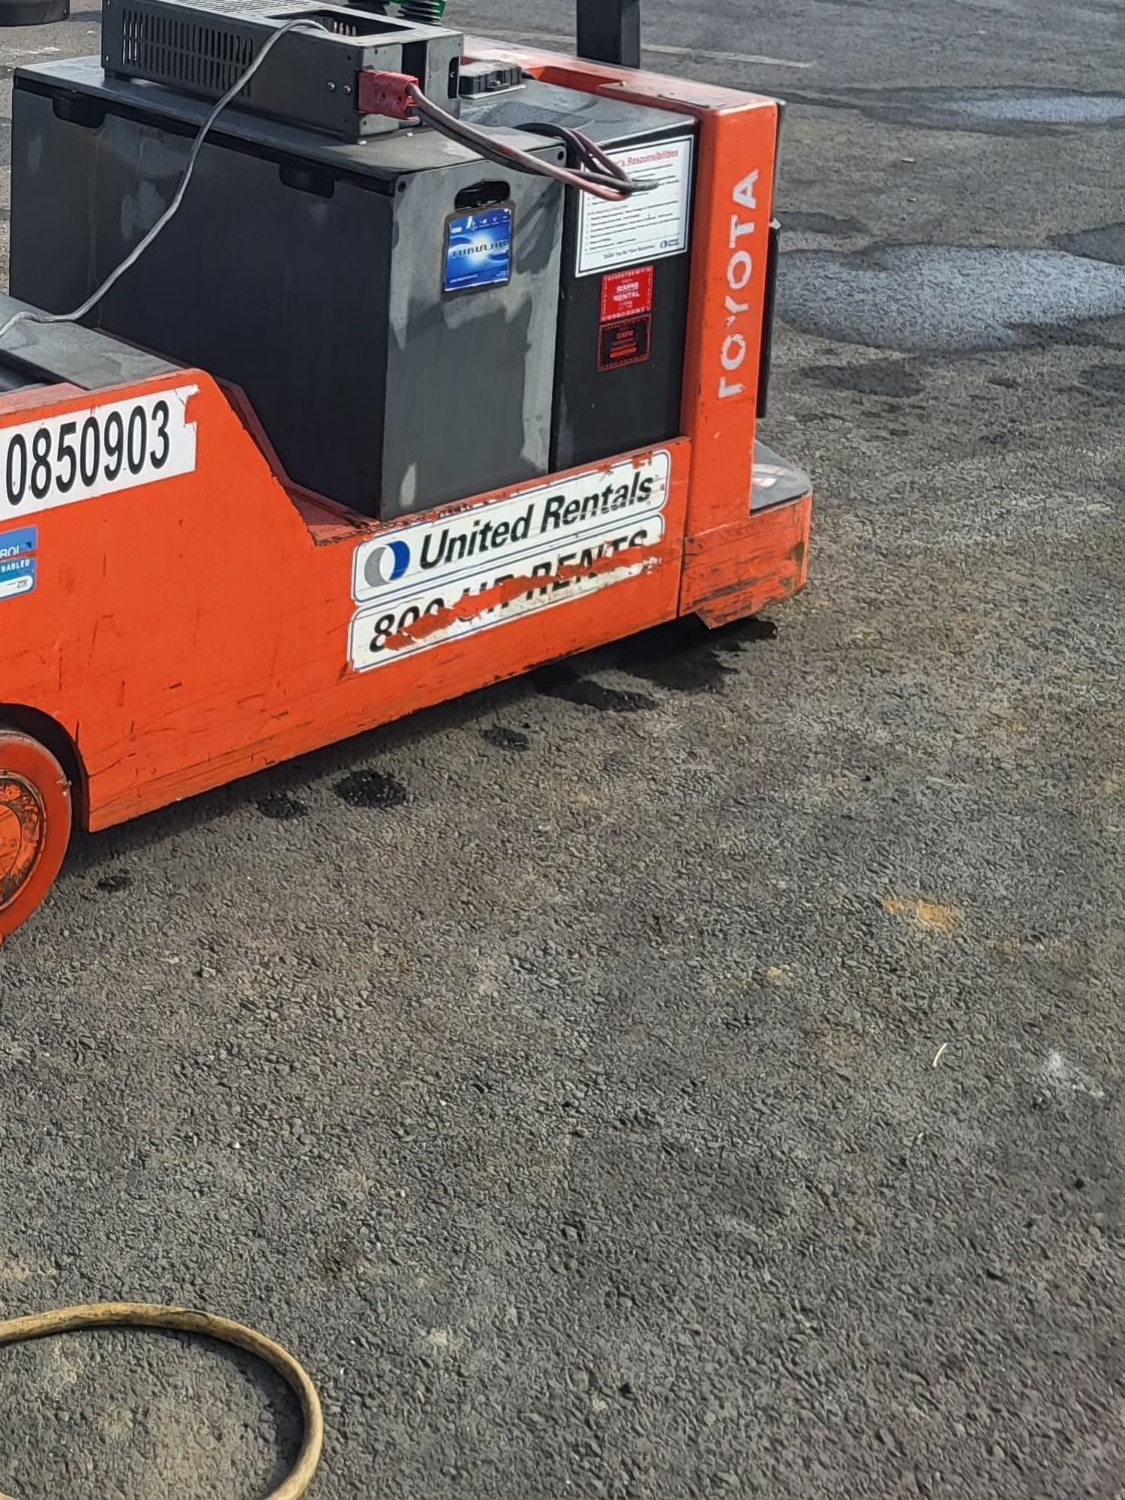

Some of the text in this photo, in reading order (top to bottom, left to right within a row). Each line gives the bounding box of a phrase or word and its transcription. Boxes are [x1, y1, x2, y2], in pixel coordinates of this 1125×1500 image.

[718, 169, 759, 399] TOYOTA
[420, 470, 654, 570] United Rentals
